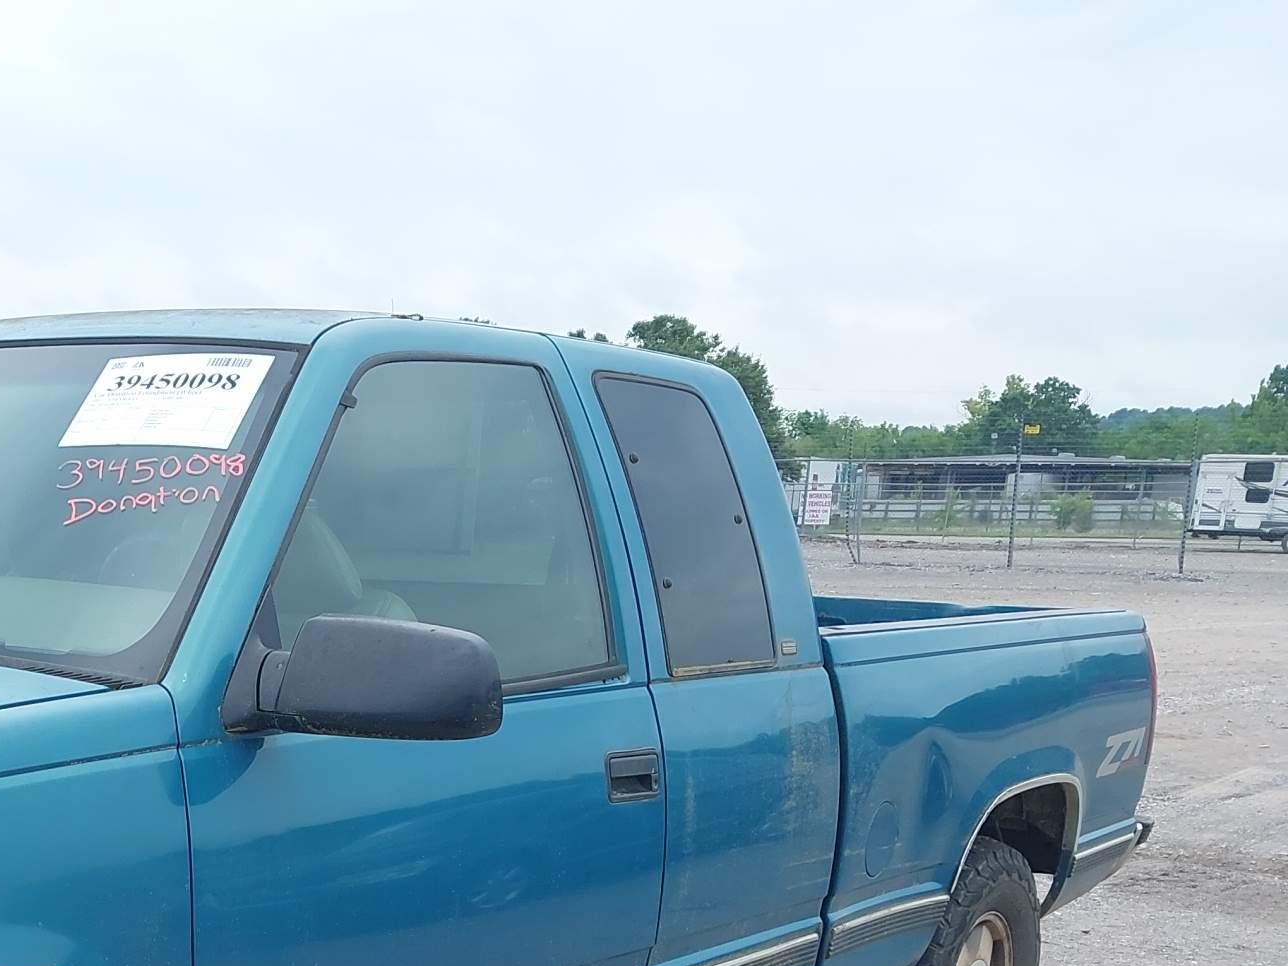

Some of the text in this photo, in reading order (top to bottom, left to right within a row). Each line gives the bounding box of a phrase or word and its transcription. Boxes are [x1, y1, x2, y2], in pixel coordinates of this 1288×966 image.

[107, 372, 241, 392] 39450098
[55, 453, 246, 489] 39450098
[63, 485, 220, 526] Donation
